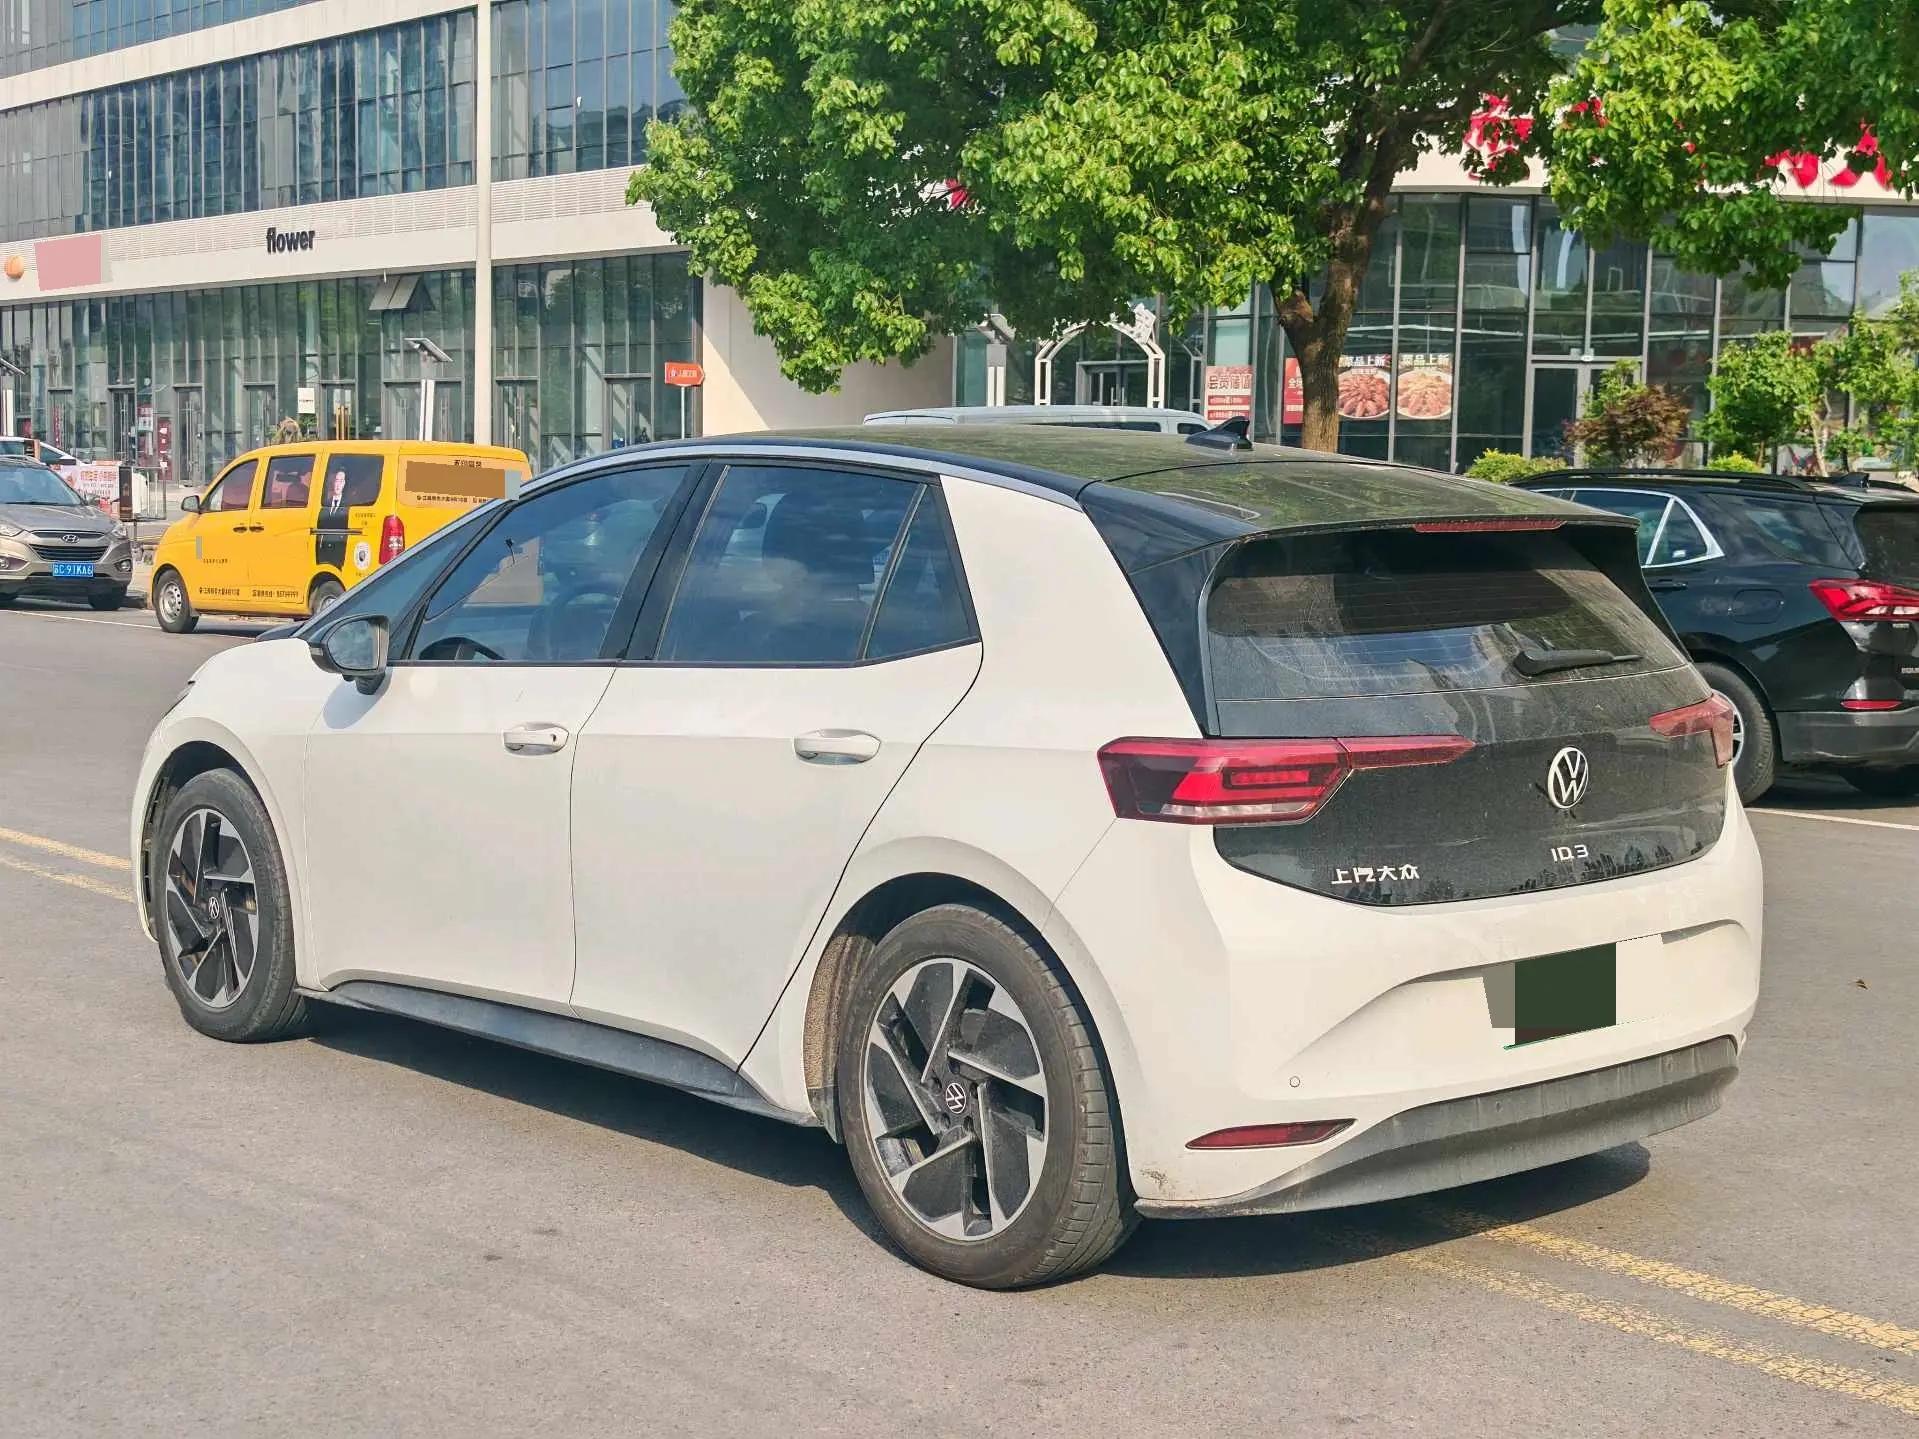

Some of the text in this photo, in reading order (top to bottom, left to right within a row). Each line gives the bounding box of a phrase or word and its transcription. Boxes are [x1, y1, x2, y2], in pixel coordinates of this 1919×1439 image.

[266, 226, 315, 253] flower
[1331, 863, 1420, 885] 上汽大众
